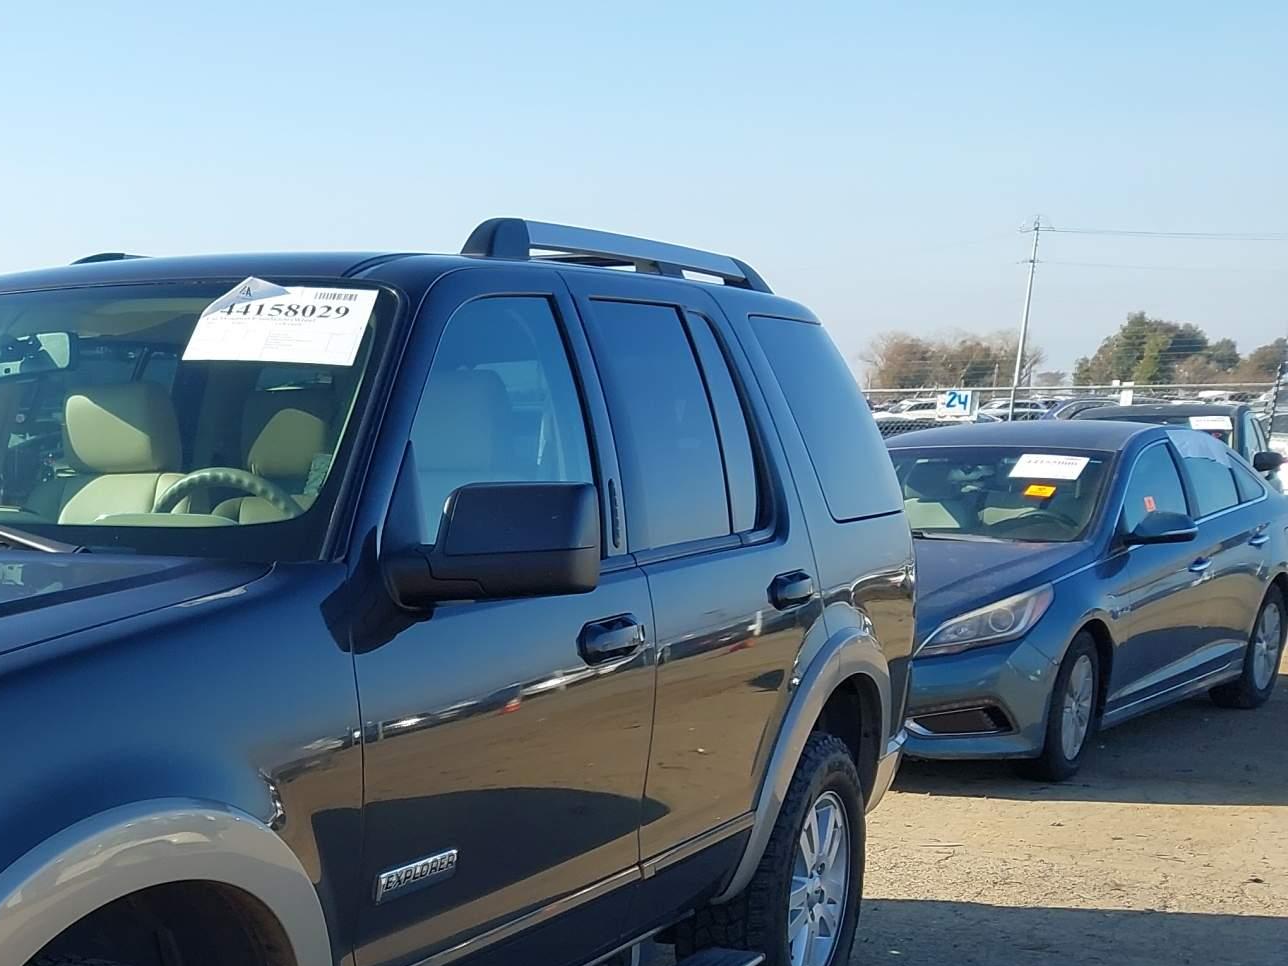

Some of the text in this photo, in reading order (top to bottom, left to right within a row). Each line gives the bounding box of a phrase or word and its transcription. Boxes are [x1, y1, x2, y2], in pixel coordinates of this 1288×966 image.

[219, 302, 350, 320] 44158029
[946, 391, 969, 410] 24
[383, 853, 456, 891] EXPLORER
